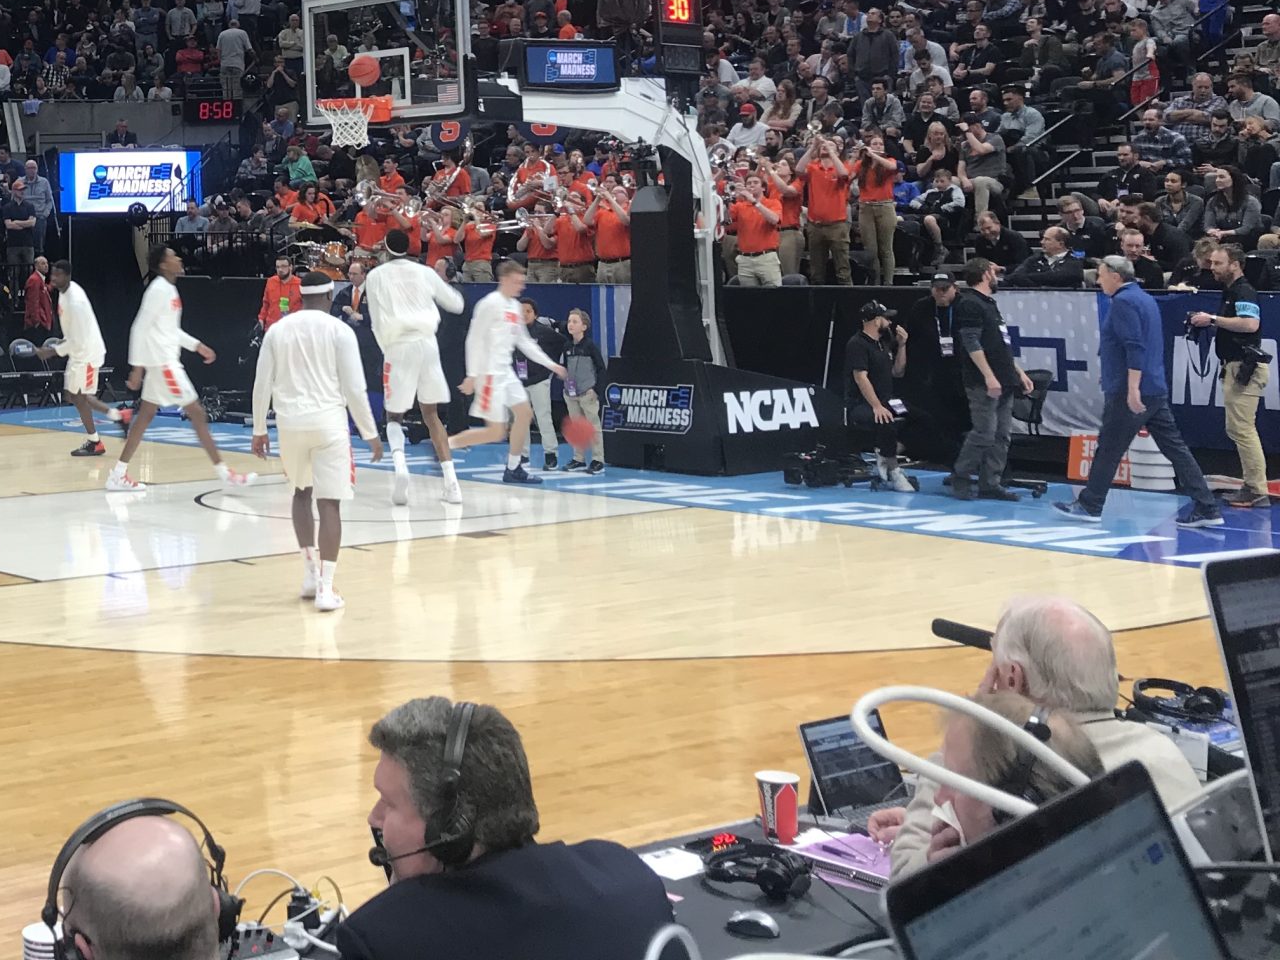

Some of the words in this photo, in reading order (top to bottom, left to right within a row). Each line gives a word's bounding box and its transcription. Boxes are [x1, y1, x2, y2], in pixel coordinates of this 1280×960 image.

[556, 52, 583, 64] MARCH
[560, 64, 596, 75] MADNESS
[199, 101, 233, 120] 8:58
[106, 166, 151, 180] MARCH
[111, 180, 172, 193] MADNESS
[621, 388, 668, 406] MARCH
[627, 406, 691, 425] MADNESS
[723, 387, 820, 434] NCAA
[760, 502, 1177, 551] FINAL
